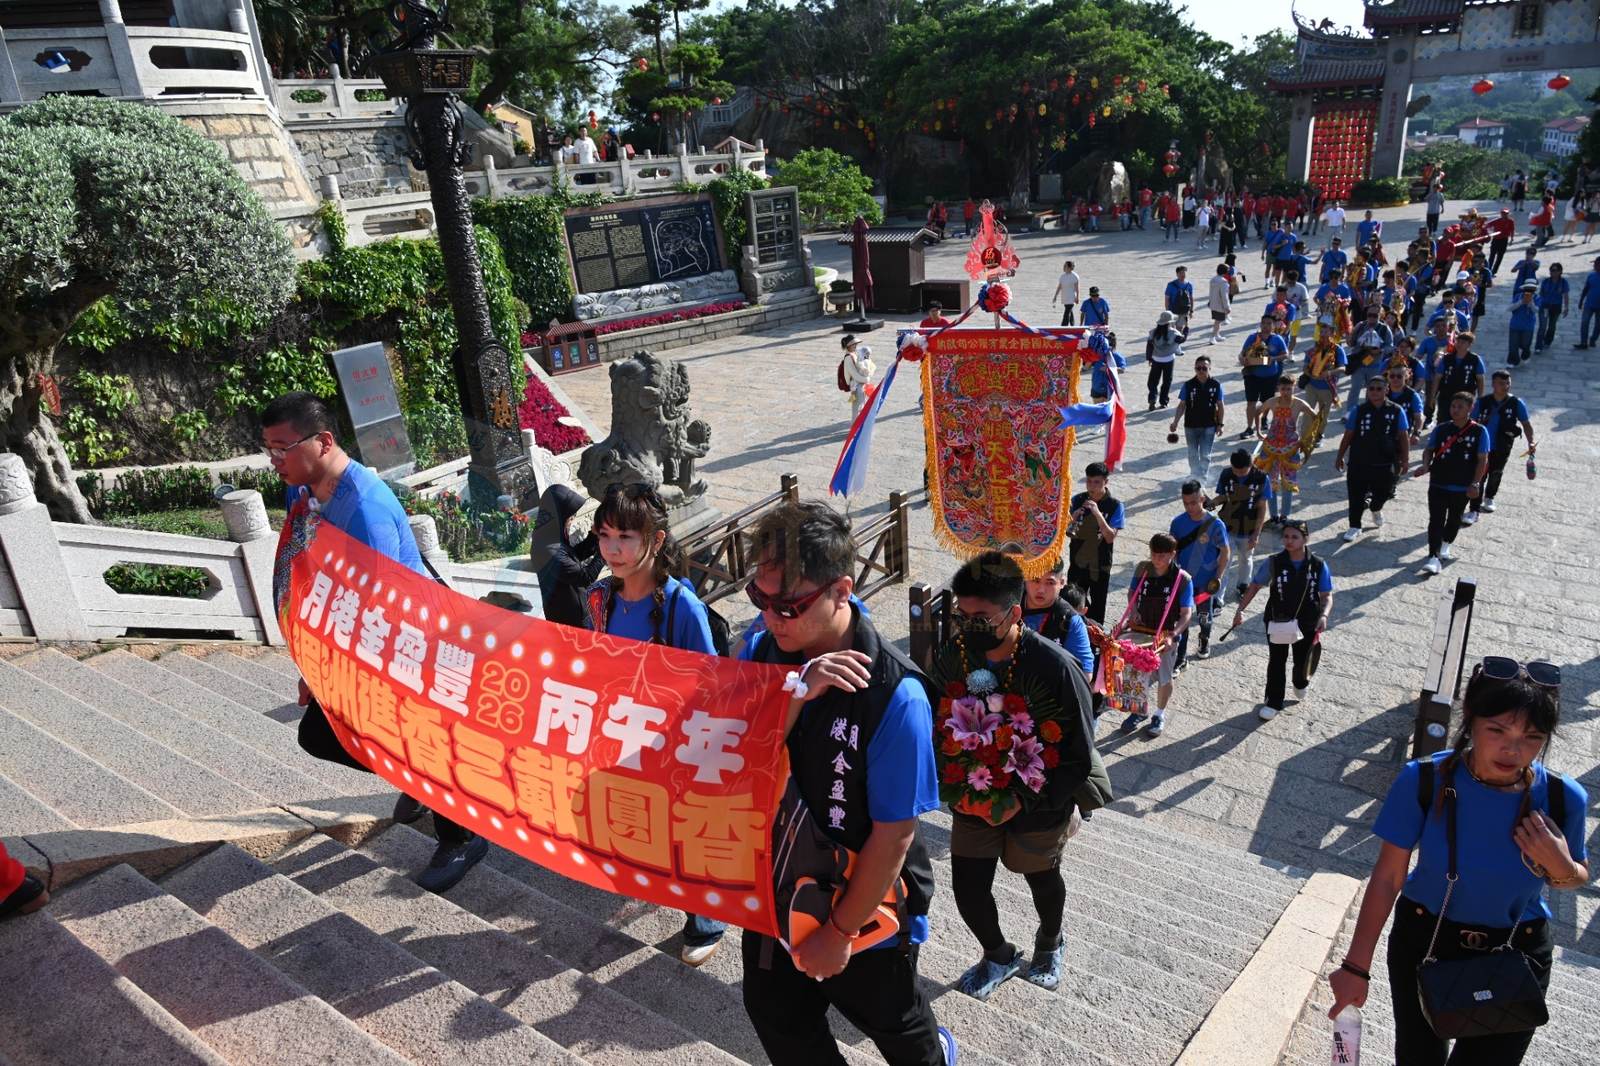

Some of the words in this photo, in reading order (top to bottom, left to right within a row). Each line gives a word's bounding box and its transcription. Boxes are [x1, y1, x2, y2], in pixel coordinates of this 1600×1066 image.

[987, 441, 1013, 524] 天上聖母
[300, 570, 476, 717] 月港金盈豐
[532, 677, 748, 785] 丙午年
